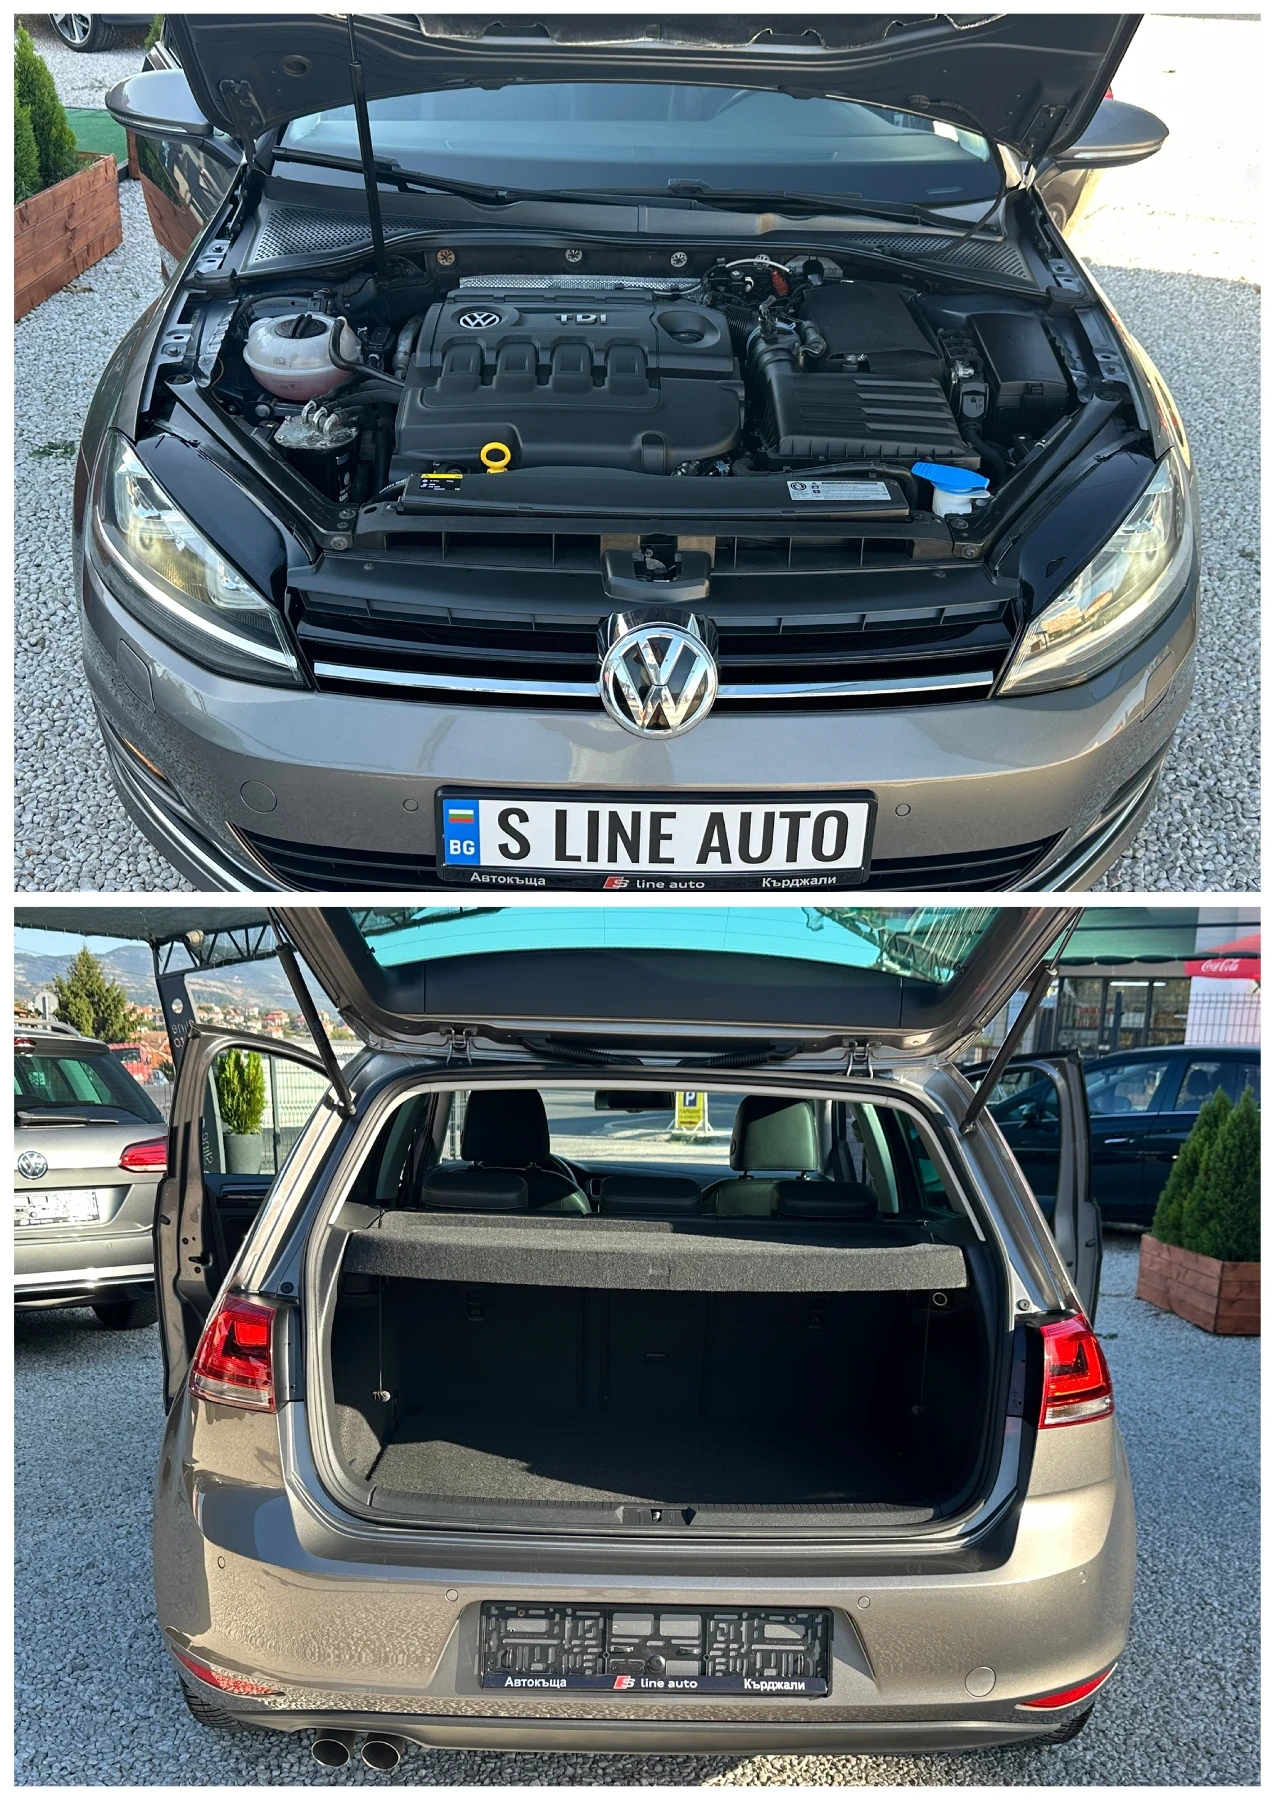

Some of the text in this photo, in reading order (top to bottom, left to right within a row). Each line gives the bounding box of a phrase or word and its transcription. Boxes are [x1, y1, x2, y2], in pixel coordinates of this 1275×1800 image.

[555, 313, 608, 325] TDI
[497, 807, 849, 865] S LINE AUTO
[449, 841, 475, 856] BG
[470, 872, 546, 886] Автокъща
[636, 879, 665, 890] line
[669, 880, 706, 890] auto
[761, 875, 837, 889] Кърджали
[685, 1091, 695, 1105] P
[504, 1676, 568, 1688] Автокъща
[640, 1678, 665, 1688] line
[667, 1679, 698, 1689] auto
[743, 1678, 806, 1691] Кърджали
